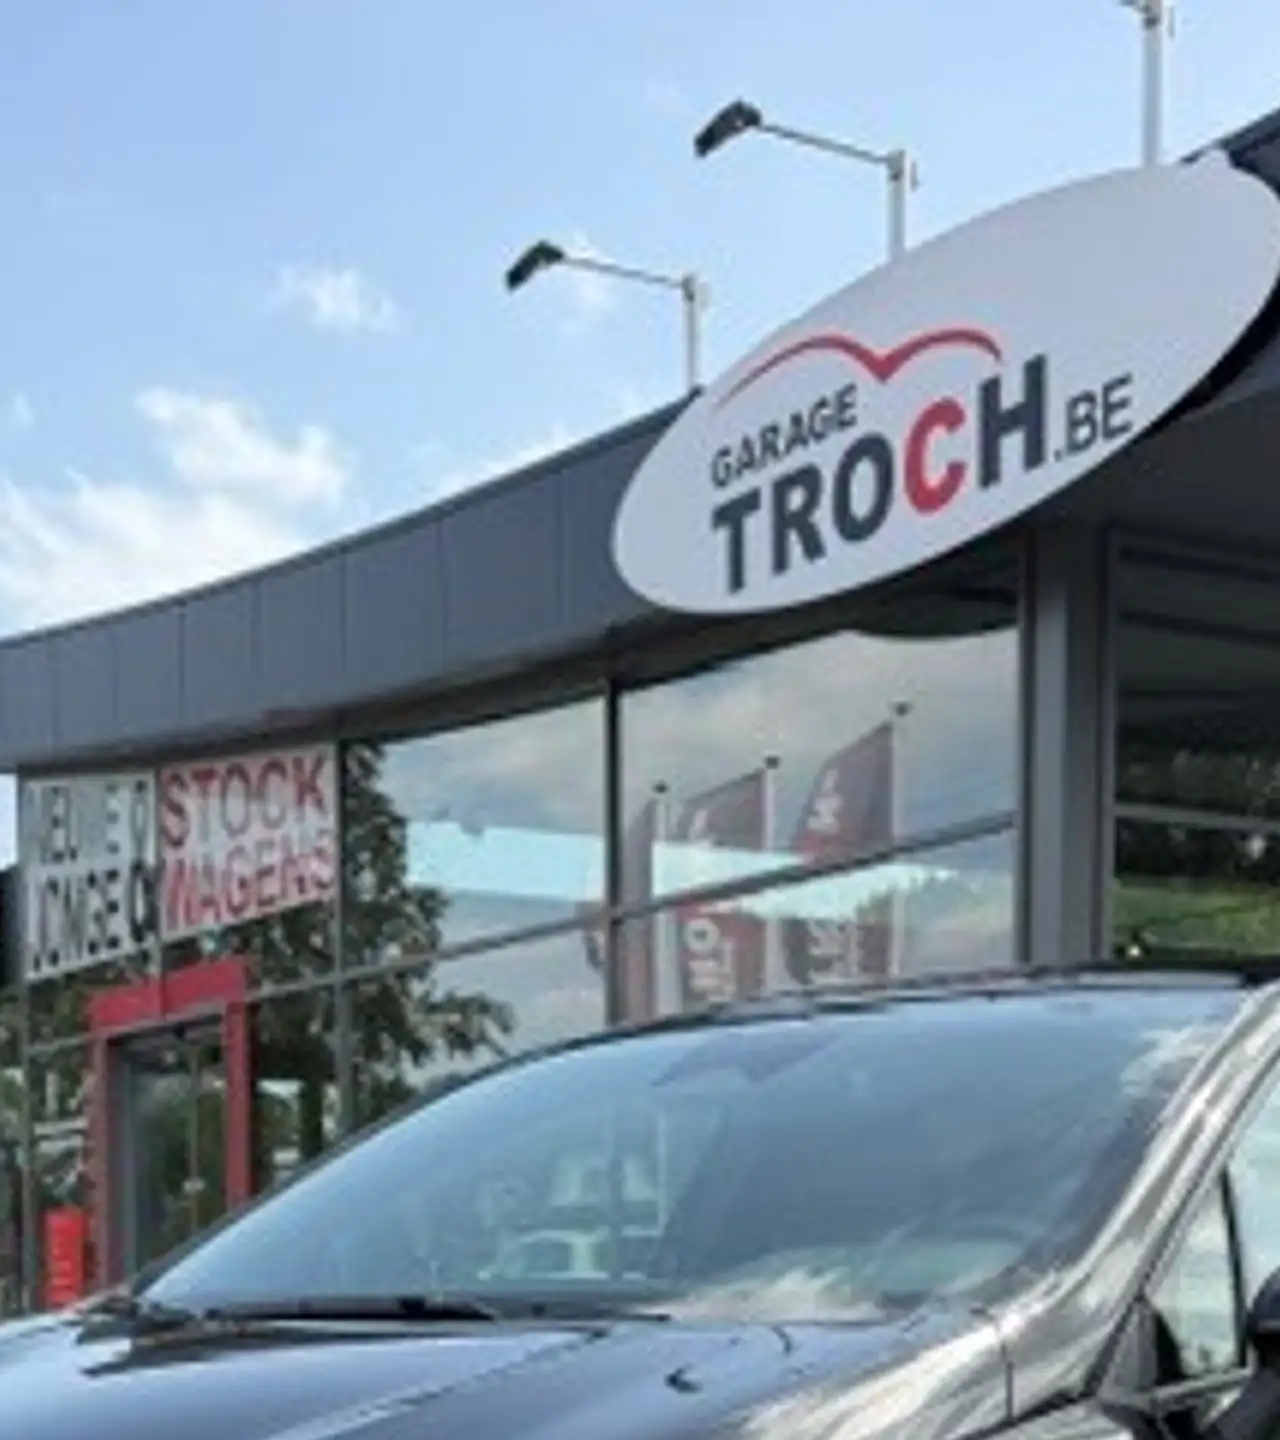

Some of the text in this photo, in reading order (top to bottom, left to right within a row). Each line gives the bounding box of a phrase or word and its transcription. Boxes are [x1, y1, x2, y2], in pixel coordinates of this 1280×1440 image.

[710, 384, 859, 489] GARAGE
[161, 757, 327, 849] STOCK
[163, 829, 336, 932] WAGENS
